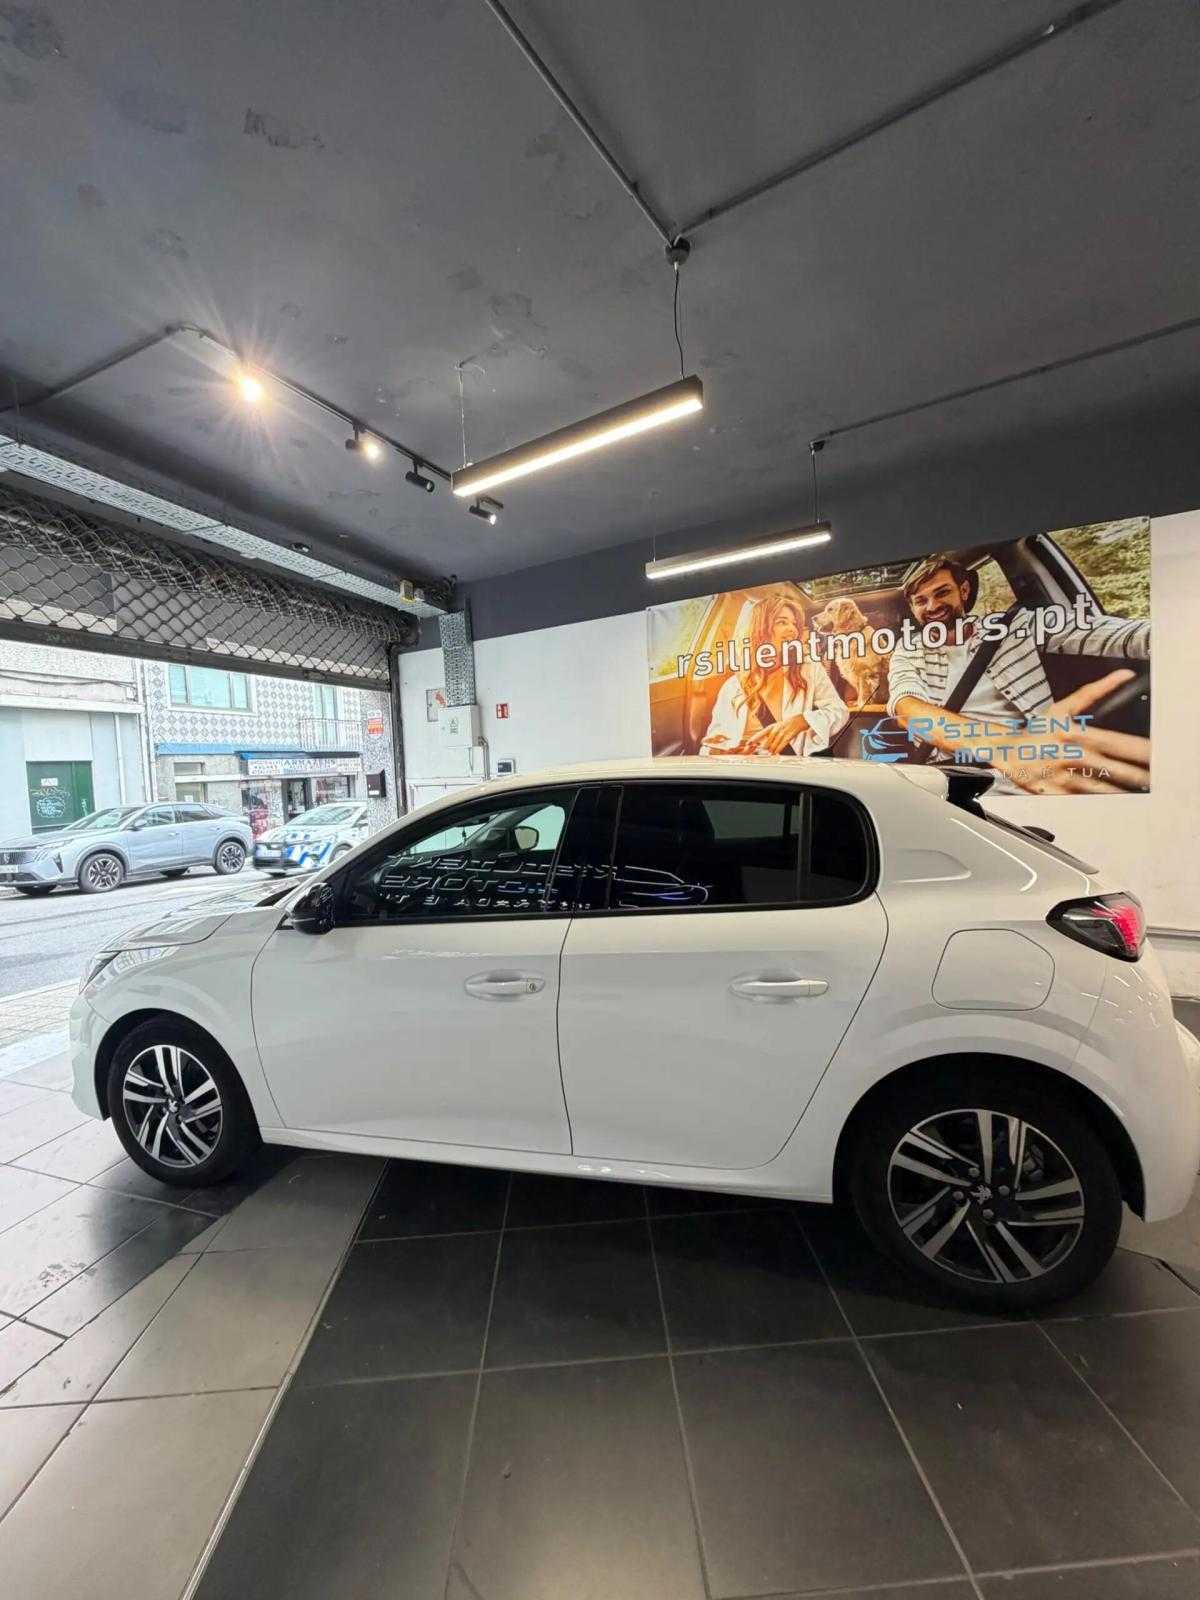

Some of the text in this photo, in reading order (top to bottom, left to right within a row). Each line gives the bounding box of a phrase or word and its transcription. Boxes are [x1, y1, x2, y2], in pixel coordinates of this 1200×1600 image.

[676, 592, 1093, 678] rsilientmotors.pt
[907, 714, 1094, 742] R'SILIENT
[954, 743, 1084, 764] MOTORS
[1066, 767, 1111, 778] TUA
